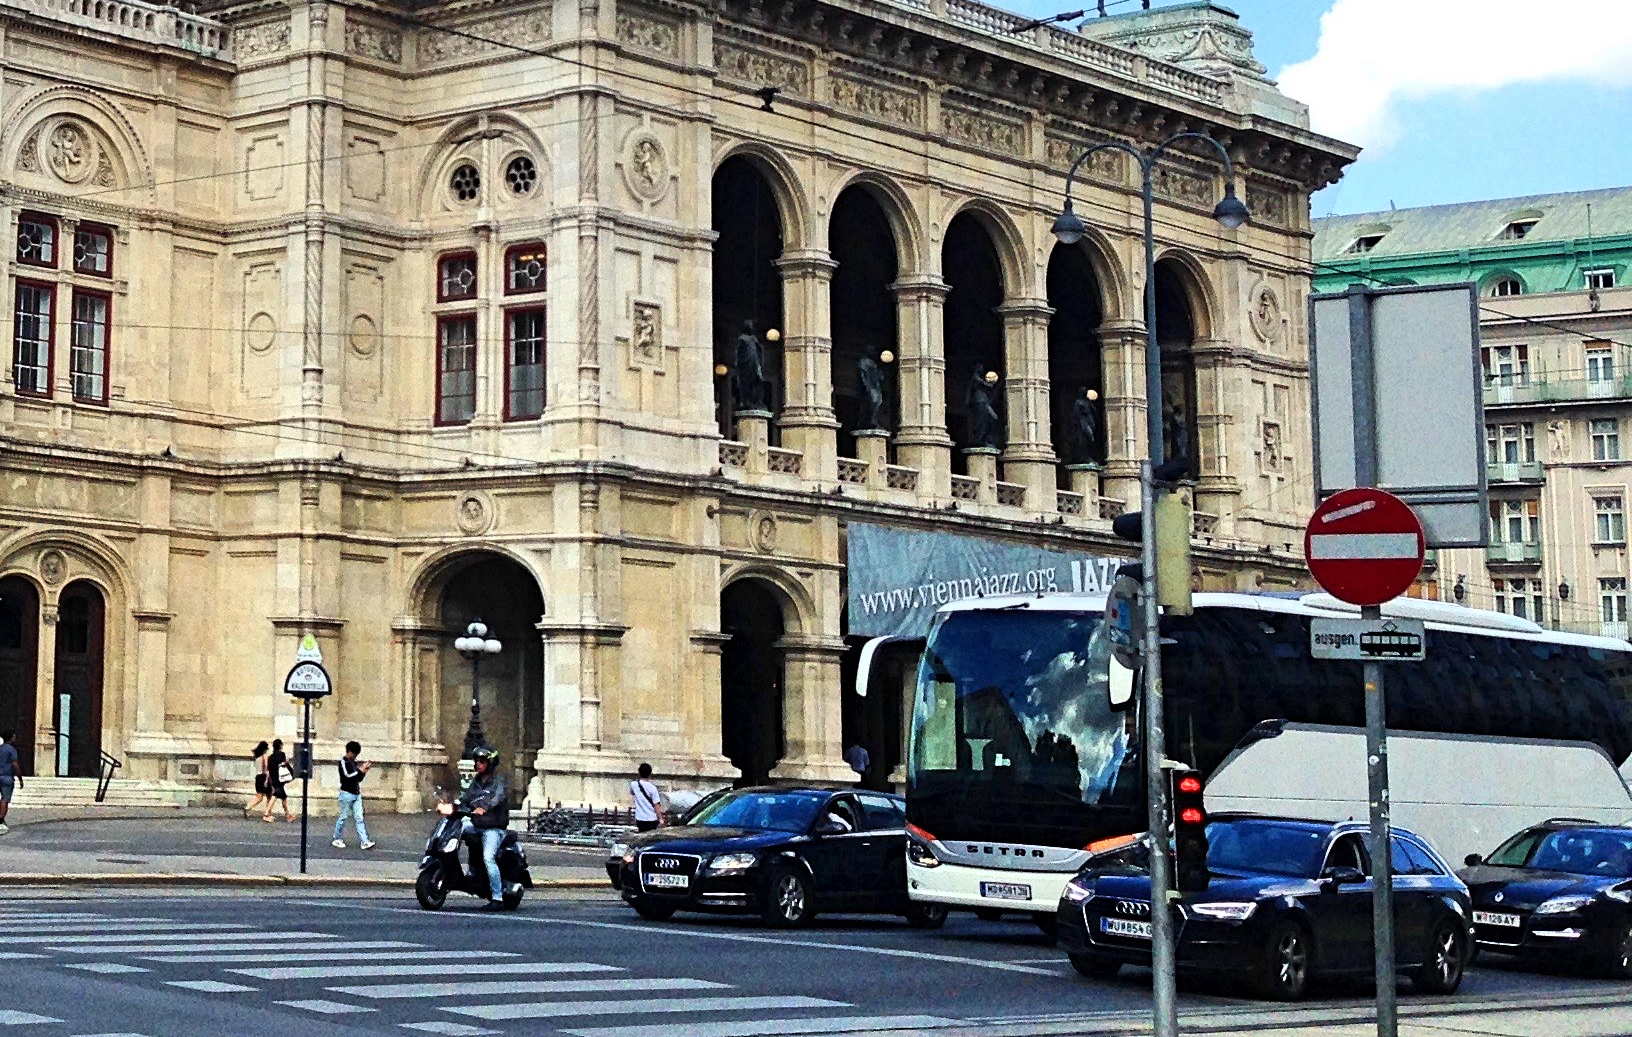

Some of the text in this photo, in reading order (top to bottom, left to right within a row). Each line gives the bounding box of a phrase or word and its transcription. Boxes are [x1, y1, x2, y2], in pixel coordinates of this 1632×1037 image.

[860, 567, 1058, 615] www.viennajazz.org
[1314, 632, 1359, 649] ausgen.
[966, 845, 1045, 858] SETRA
